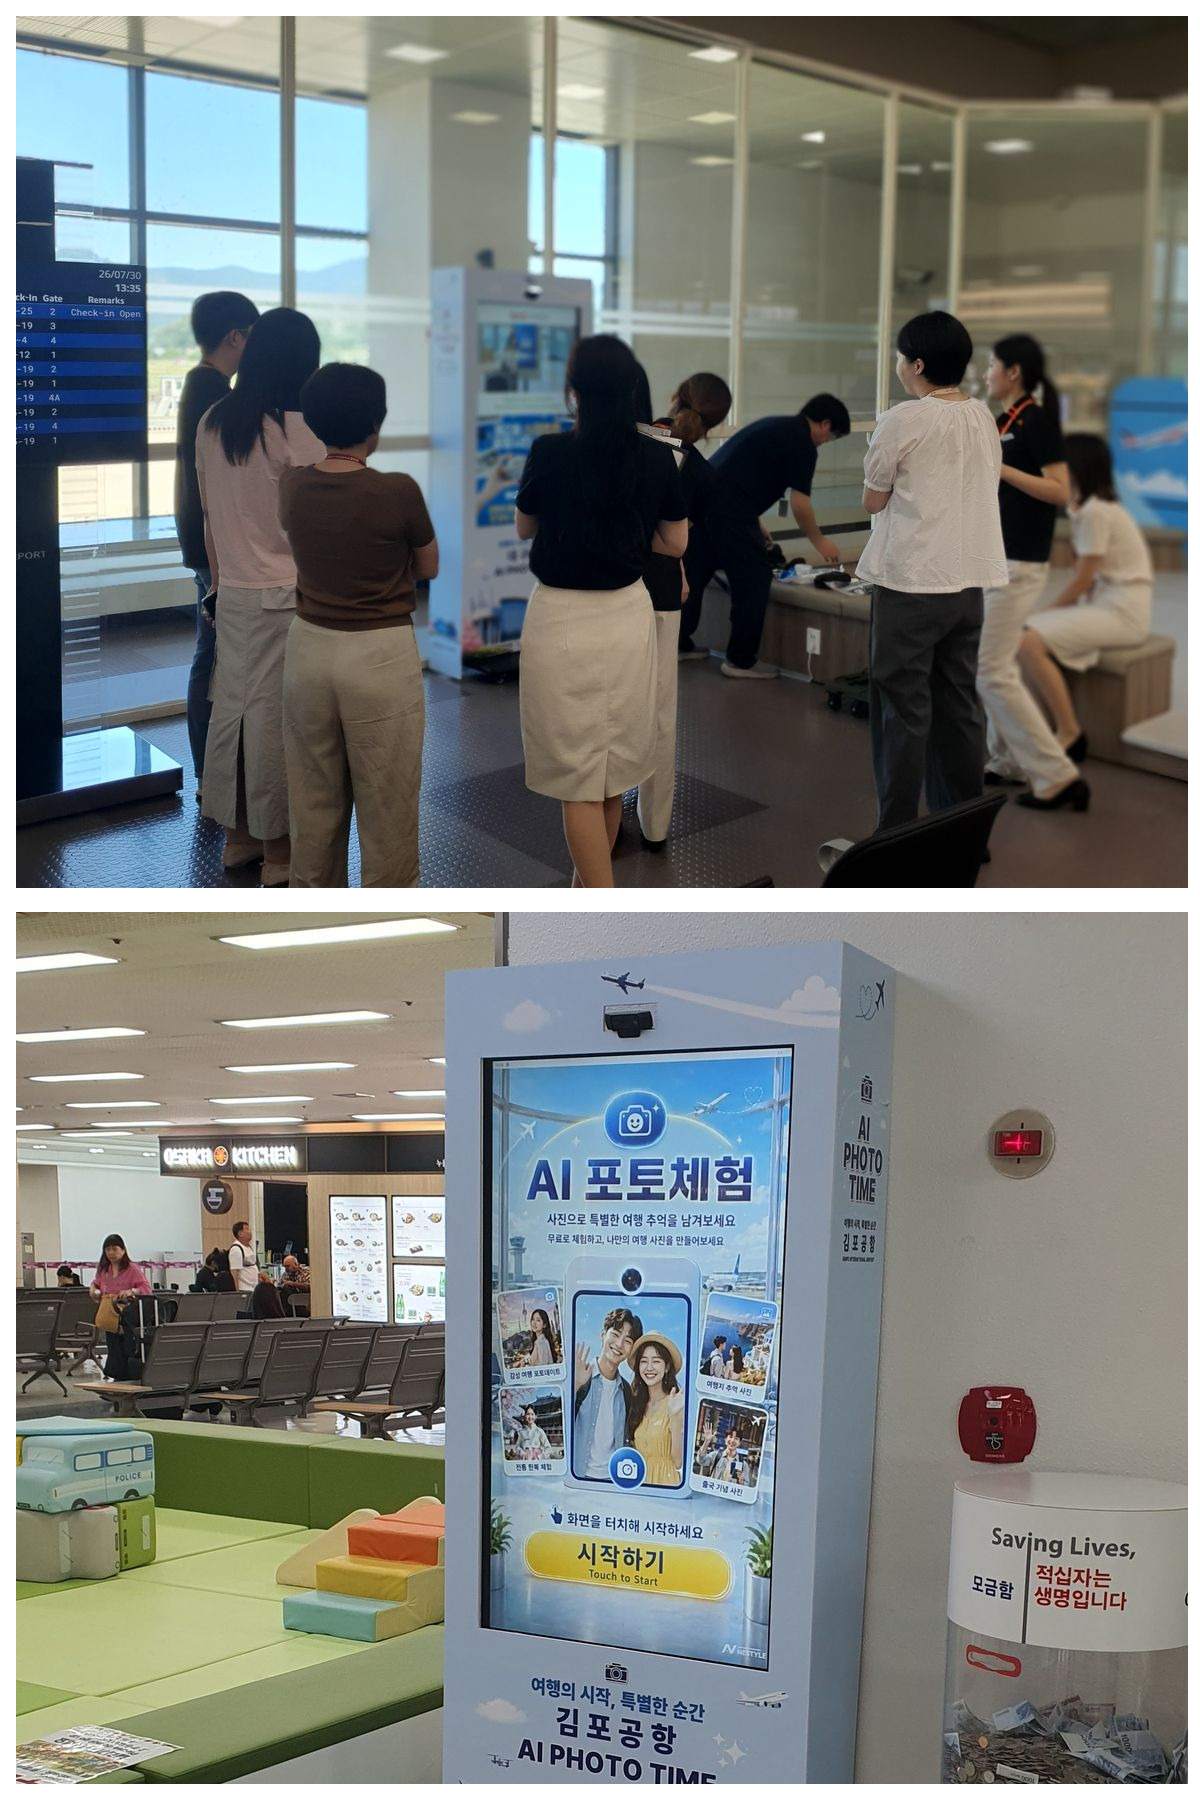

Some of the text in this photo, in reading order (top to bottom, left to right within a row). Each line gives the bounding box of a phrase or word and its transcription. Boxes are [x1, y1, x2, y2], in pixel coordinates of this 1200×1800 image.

[99, 270, 142, 280] 26/07/30
[115, 284, 141, 293] 13:35
[43, 295, 63, 303] Gate
[88, 296, 125, 305] Remarks
[50, 308, 56, 316] 2
[70, 308, 115, 317] Check-in
[120, 310, 141, 319] Open
[50, 322, 56, 330] 3
[50, 336, 56, 344] 4
[51, 365, 57, 373] 2
[48, 394, 60, 402] 4A
[52, 408, 58, 416] 2
[53, 436, 57, 444] 1
[858, 1115, 870, 1142] AI
[164, 1146, 297, 1166] OSAKA KITCHEN
[843, 1142, 882, 1174] PHOTO
[526, 1156, 752, 1202] AI 포토체험
[850, 1174, 876, 1202] TIME
[547, 1213, 736, 1228] 사진으로 특별한 여행 추억을 남겨보세요
[548, 1234, 724, 1247] 무료로 체험하고, 나만의 여행 사진을 만들어보세요
[843, 1233, 875, 1253] 김포공항
[522, 1370, 532, 1378] 여행
[706, 1380, 752, 1396] 여행지 추억 사진
[115, 1472, 142, 1482] POLICE
[702, 1480, 743, 1496] 출국 기념 사진
[567, 1513, 704, 1540] 화면을 터치해 시작하세요
[992, 1527, 1136, 1560] Saving Lives,
[577, 1542, 664, 1574] 시작하기
[588, 1569, 658, 1587] Touch to Start
[1036, 1565, 1112, 1588] 적십자는
[972, 1575, 1014, 1600] 모금함
[1034, 1586, 1127, 1611] 생명입니다
[531, 1677, 705, 1723] 여행의 시작, 특별한 순간
[556, 1707, 677, 1755] 김포공항
[518, 1738, 543, 1763] AI
[550, 1744, 642, 1781] PHOTO
